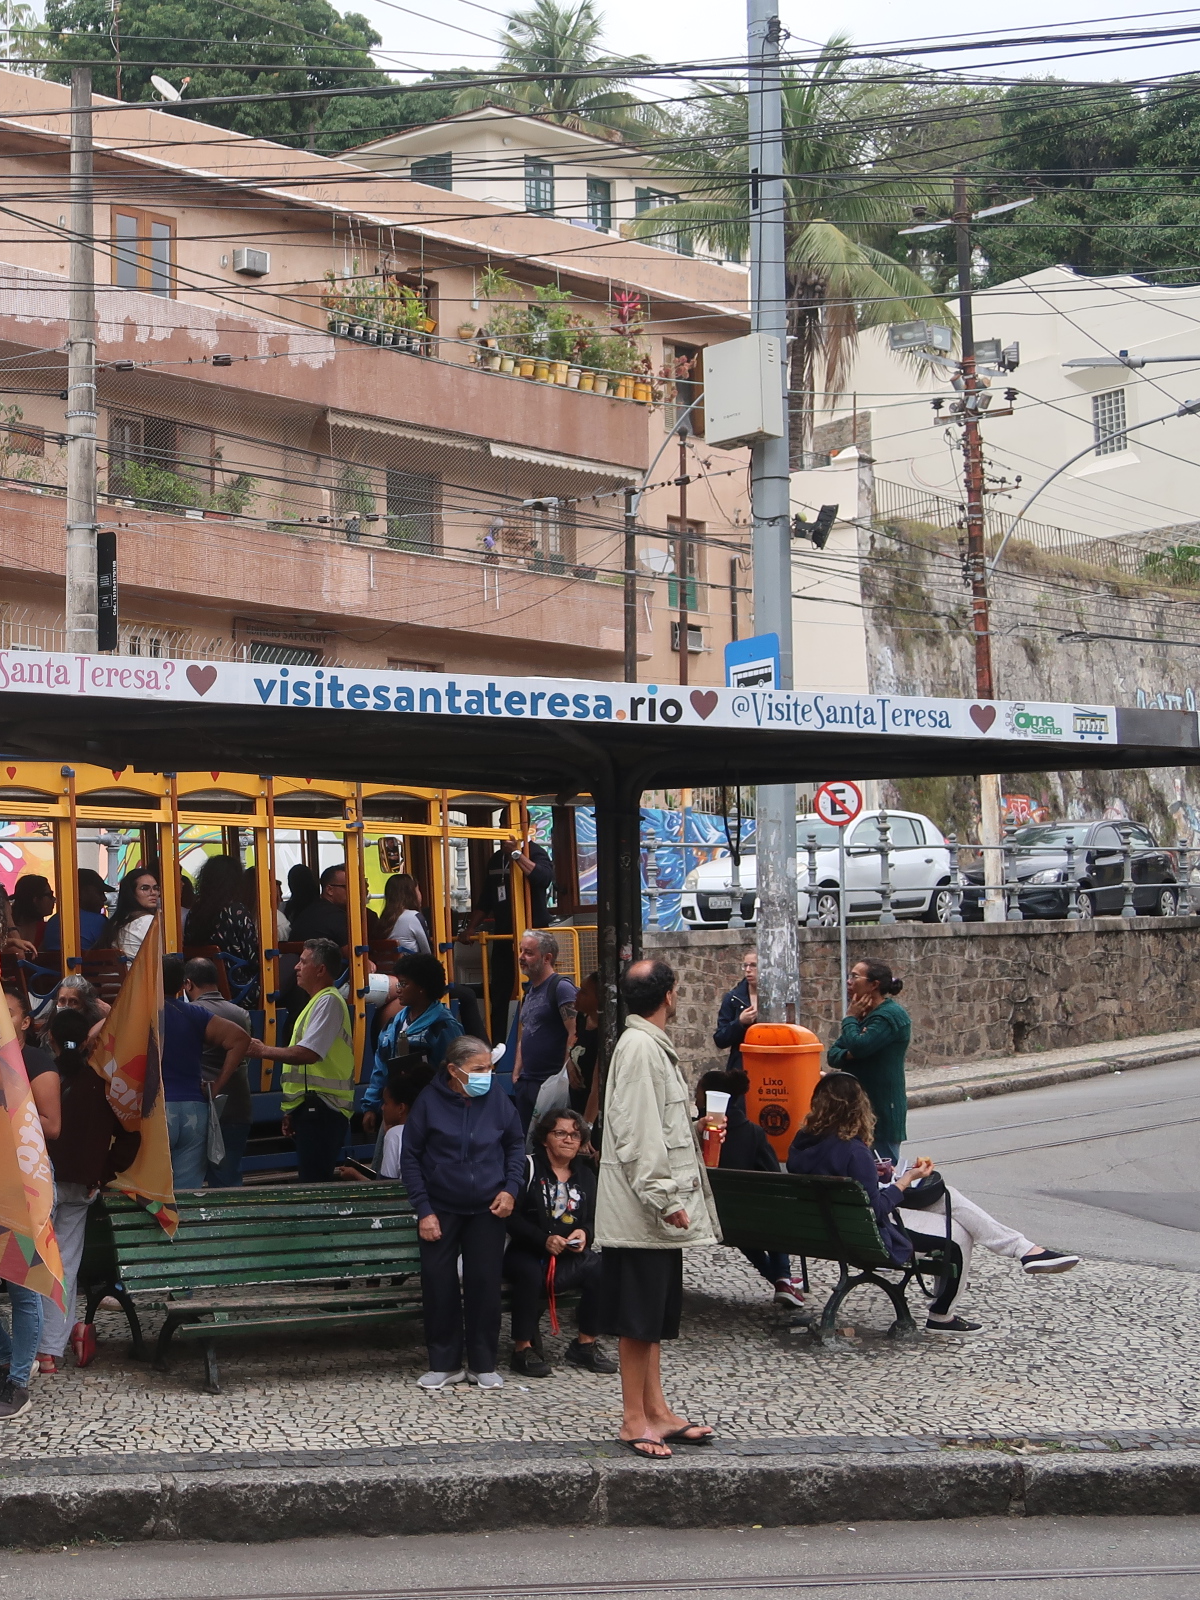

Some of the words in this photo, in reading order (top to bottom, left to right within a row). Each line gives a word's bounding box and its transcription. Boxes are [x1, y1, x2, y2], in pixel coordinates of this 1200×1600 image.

[74, 656, 176, 693] Teresa?
[253, 668, 683, 724] visitesantateresa.rio
[731, 691, 952, 733] @VisiteSantaTeresa
[1031, 724, 1063, 735] Santa
[757, 1086, 764, 1095] é
[765, 1086, 789, 1096] aqui.
[762, 1077, 783, 1086] Lixo
